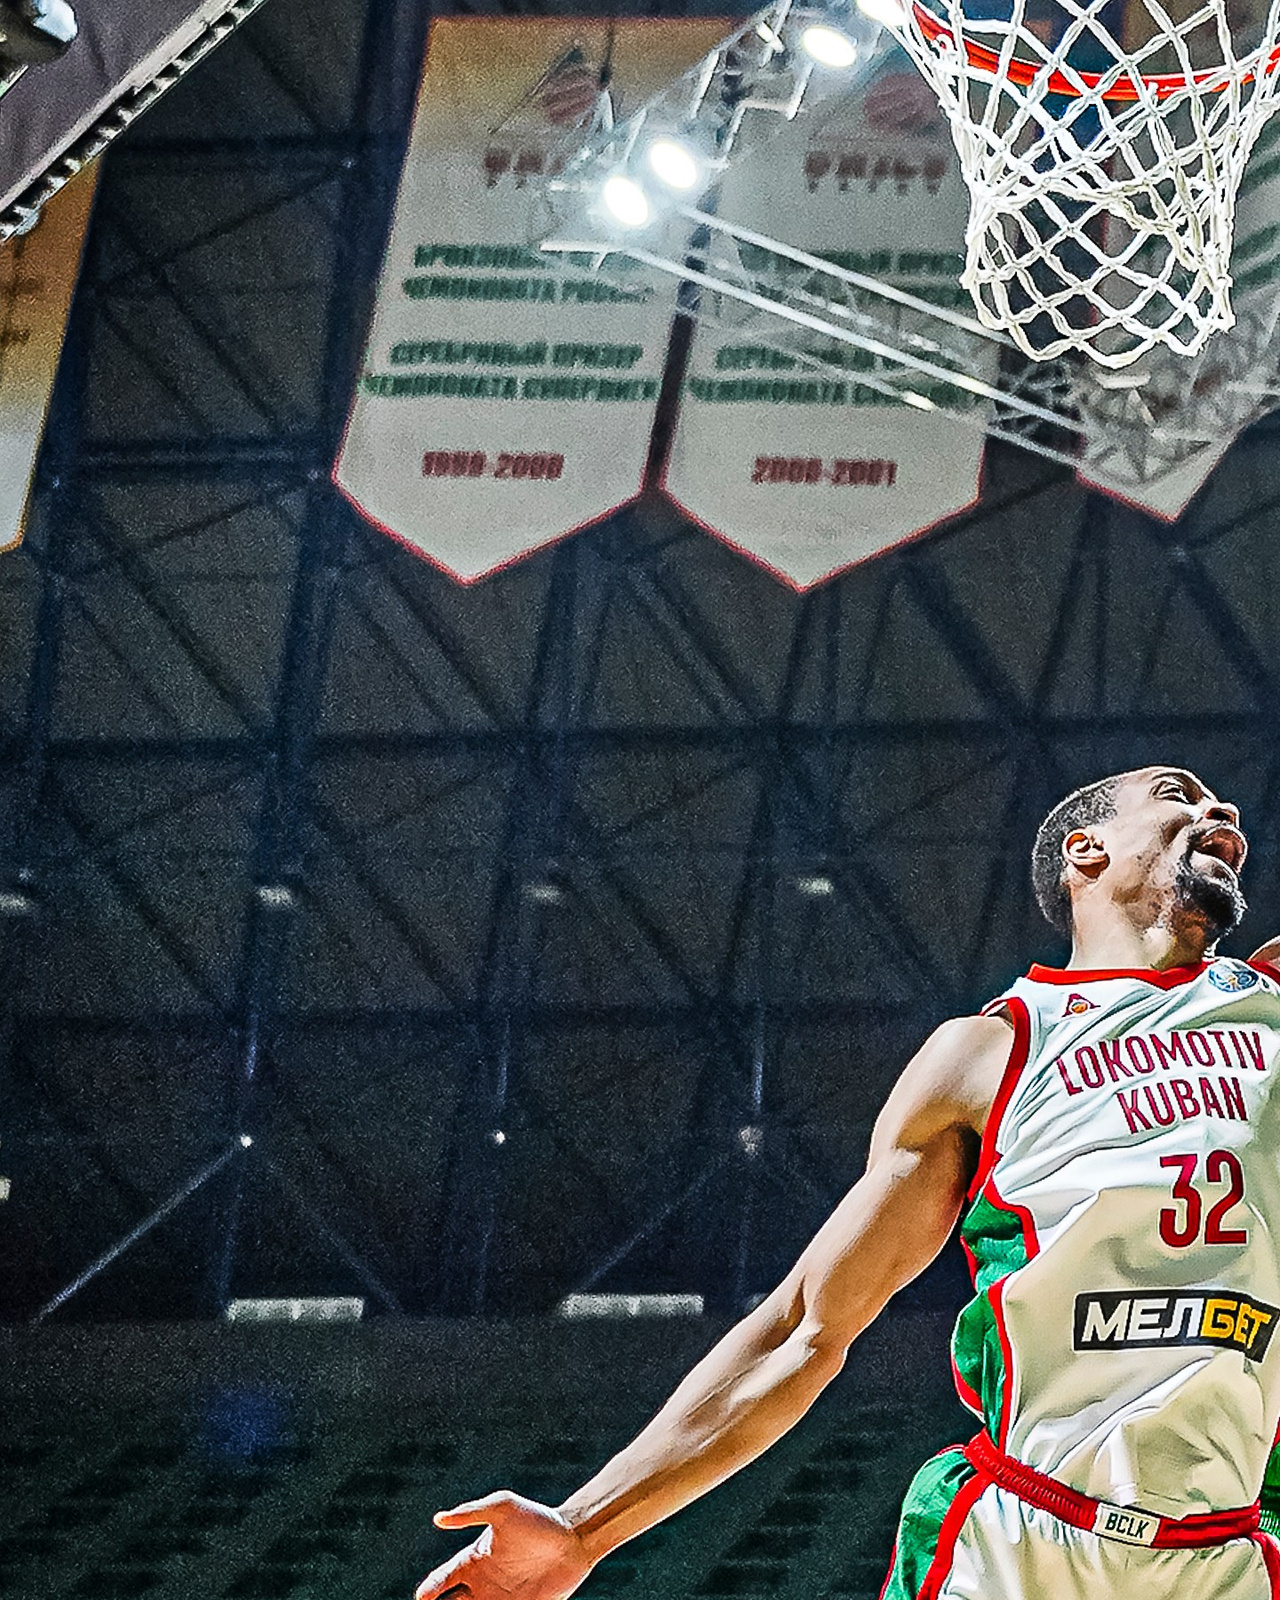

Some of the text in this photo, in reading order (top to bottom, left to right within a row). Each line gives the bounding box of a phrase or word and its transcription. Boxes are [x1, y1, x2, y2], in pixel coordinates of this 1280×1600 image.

[1057, 1030, 1266, 1096] LOKOMOTIV
[1116, 1076, 1248, 1135] KUBAN
[1159, 1150, 1247, 1248] 32
[1081, 1298, 1271, 1349] МЕЛБЕТ
[1104, 1512, 1150, 1539] BCLK
